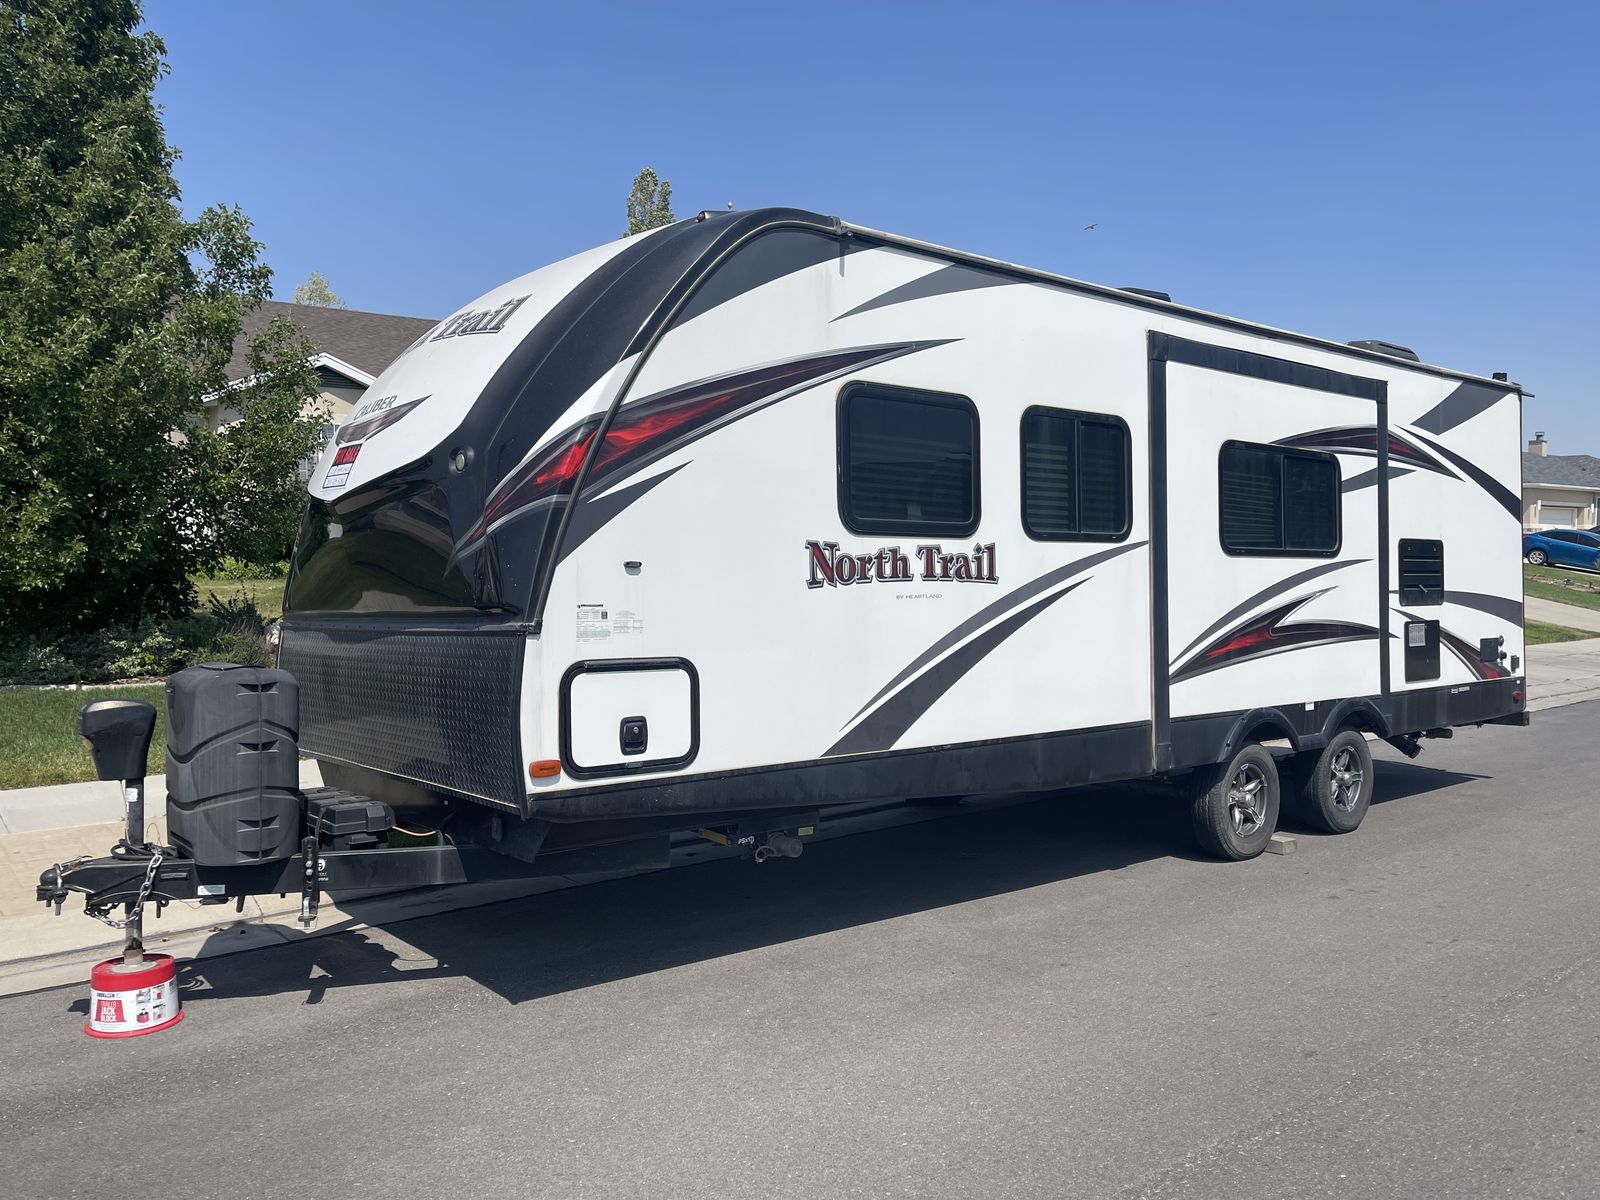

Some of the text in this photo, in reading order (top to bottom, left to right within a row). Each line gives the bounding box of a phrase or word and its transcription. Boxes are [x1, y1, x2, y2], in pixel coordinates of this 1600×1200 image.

[429, 293, 533, 343] Trail
[805, 539, 1000, 589] North Trail
